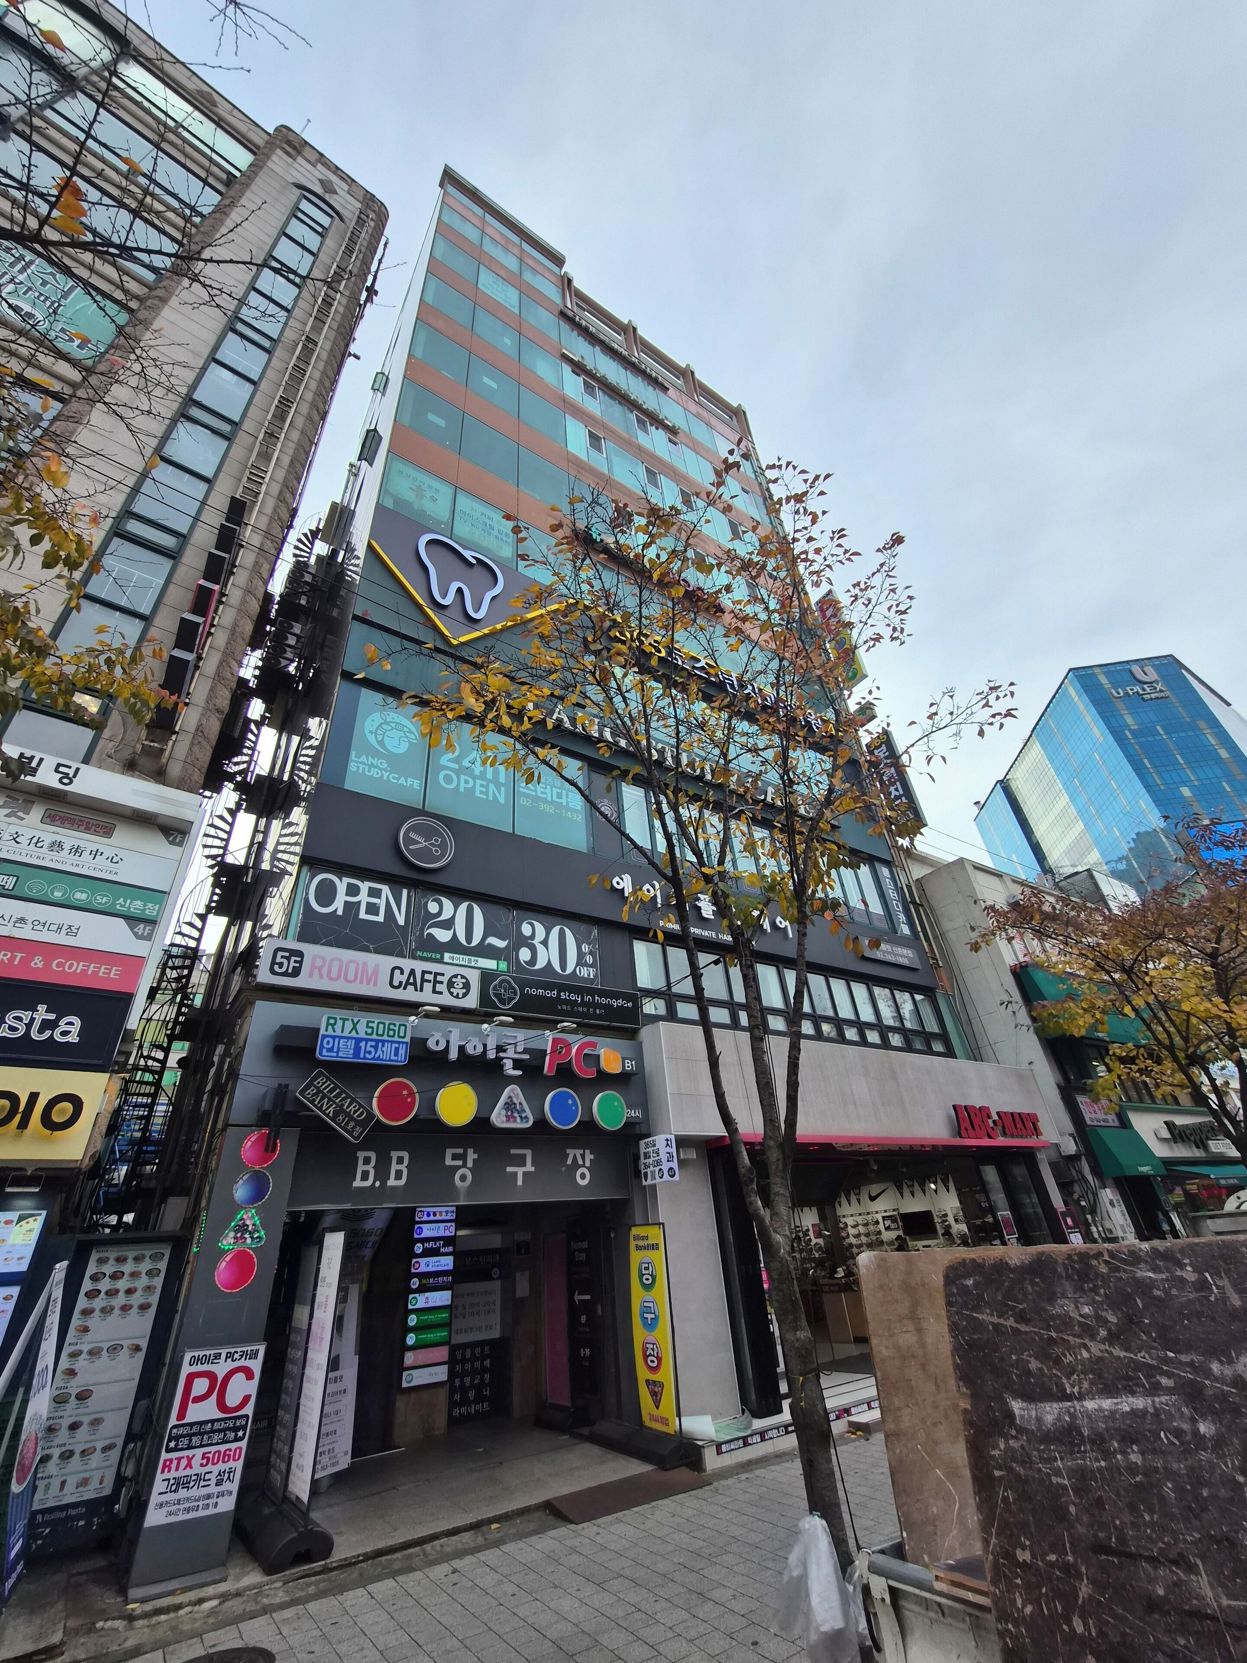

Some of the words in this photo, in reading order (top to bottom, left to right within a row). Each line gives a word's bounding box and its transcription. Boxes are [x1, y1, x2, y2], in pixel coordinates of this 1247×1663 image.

[1111, 682, 1168, 697] U-PLEX
[351, 750, 391, 771] LANG.
[350, 762, 421, 791] STUDYCAFE
[438, 770, 505, 805] OPEN
[168, 831, 184, 843] 7F
[6, 848, 47, 862] CULTURE
[49, 858, 67, 867] AND
[69, 862, 85, 871] ART
[87, 865, 119, 877] CENTER
[115, 898, 159, 917] 신촌점
[307, 872, 408, 927] OPEN
[134, 923, 152, 937] 4F
[690, 926, 717, 940] PRIVATE
[416, 951, 441, 960] NAVER
[51, 958, 122, 979] COFFEE
[273, 950, 303, 976] 5F
[307, 953, 381, 988] ROOM
[388, 965, 446, 996] CAFE
[576, 965, 597, 979] OFF
[524, 987, 558, 999] nomad
[560, 991, 581, 1005] stay
[583, 991, 593, 1003] in
[594, 993, 634, 1009] hongdae
[324, 1015, 361, 1036] RTX
[364, 1019, 408, 1040] 5060
[320, 1036, 355, 1058] 인텔
[359, 1041, 407, 1062] 15세대
[426, 1028, 530, 1076] 아이콘
[543, 1036, 599, 1079] PC
[624, 1060, 636, 1071] B1
[304, 1086, 340, 1117] BANK
[313, 1075, 367, 1121] BILLIARD
[626, 1108, 642, 1118] 24시
[664, 1137, 675, 1163] 치과
[352, 1150, 409, 1188] B.B
[443, 1225, 454, 1234] PC
[189, 1352, 222, 1367] 아이콘
[225, 1348, 259, 1362] PC카페
[176, 1365, 255, 1422] PC
[160, 1454, 196, 1475] RTX
[200, 1446, 243, 1468] 5060
[157, 1470, 213, 1496] 그래픽카드
[214, 1467, 237, 1487] 설치
